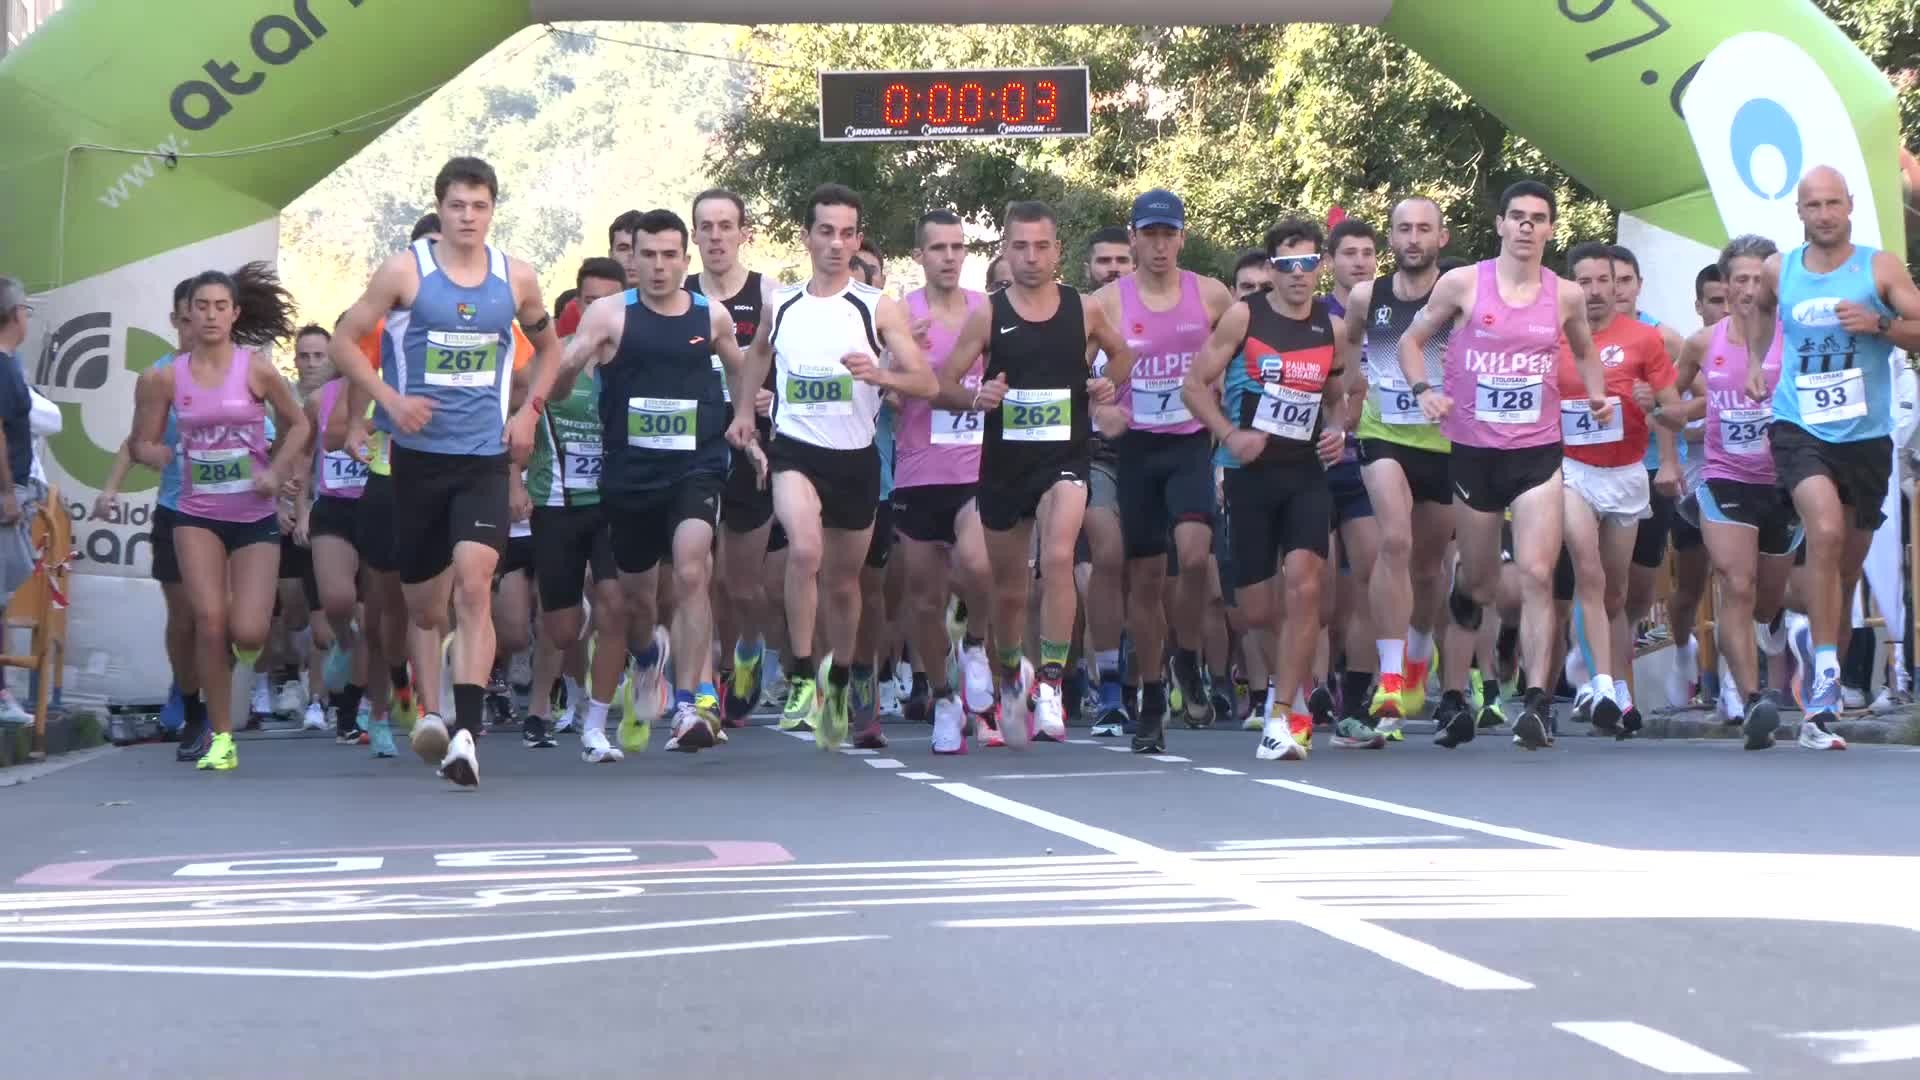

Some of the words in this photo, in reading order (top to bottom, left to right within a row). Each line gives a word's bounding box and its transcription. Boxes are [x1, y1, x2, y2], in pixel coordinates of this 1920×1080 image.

[884, 80, 1057, 124] 0:00:03
[437, 350, 487, 370] 267
[1285, 360, 1321, 373] PAULINO
[1465, 350, 1553, 374] IXILPEN
[794, 380, 842, 401] 308
[1487, 391, 1533, 410] 128
[1815, 387, 1847, 408] 93
[1158, 393, 1171, 410] 7
[640, 414, 687, 434] 300
[1013, 406, 1061, 426] 262
[1270, 402, 1311, 426] 104
[200, 463, 241, 481] 284
